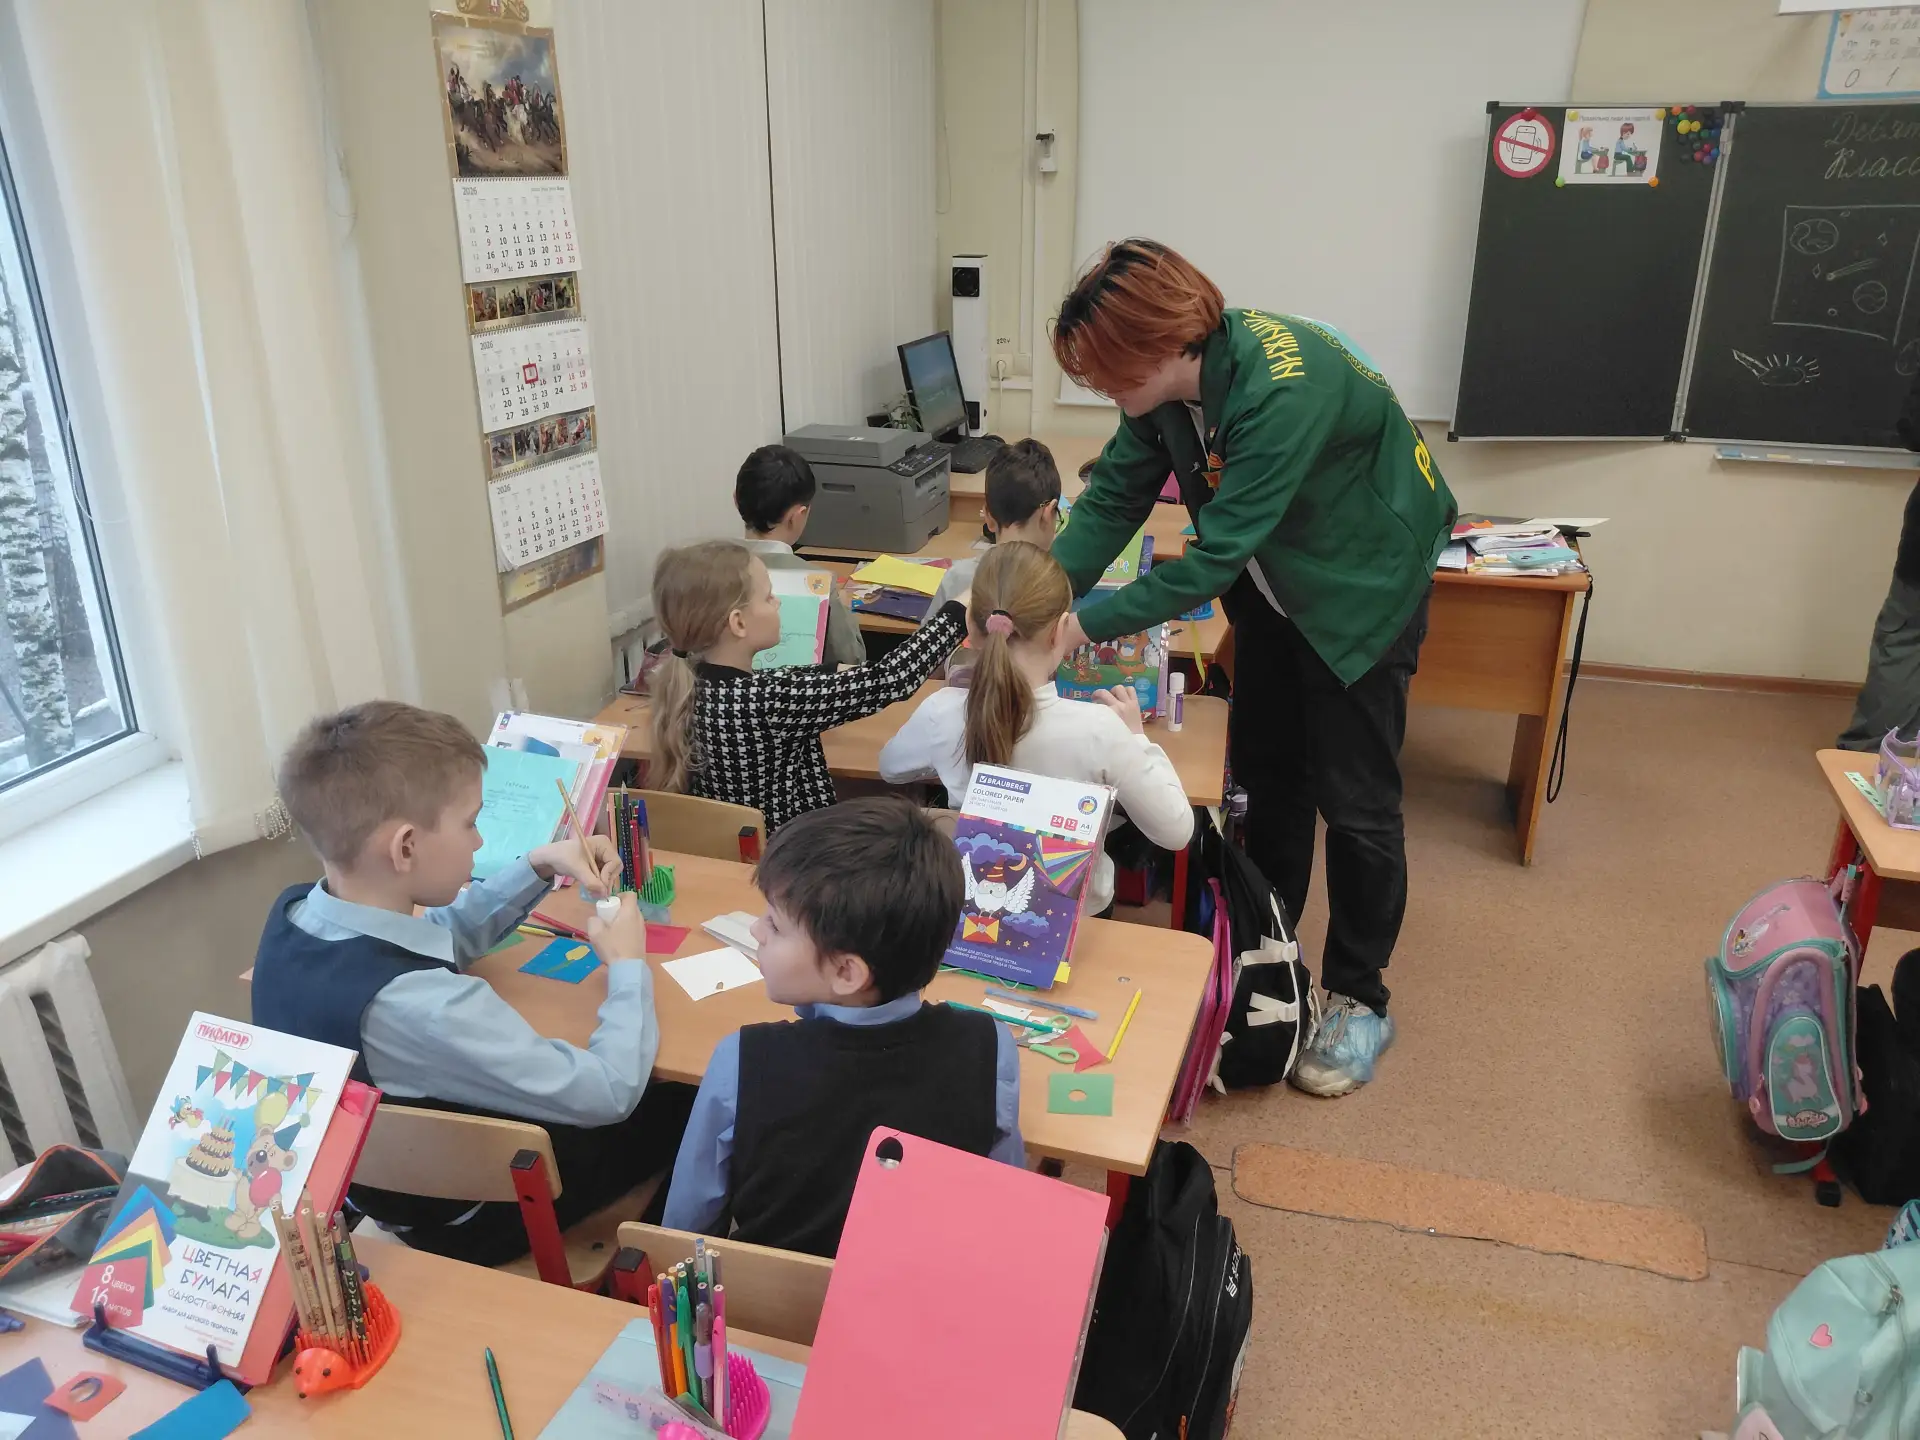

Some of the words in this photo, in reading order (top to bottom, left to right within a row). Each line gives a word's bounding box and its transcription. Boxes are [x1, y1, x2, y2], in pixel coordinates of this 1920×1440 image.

[462, 187, 477, 195] 2026
[480, 341, 493, 350] 2026
[496, 484, 511, 494] 2026
[973, 787, 1002, 799] COLORED
[1003, 794, 1025, 804] PAPER
[987, 777, 1024, 790] BRAUBERG
[198, 1024, 249, 1046] ПИФАГОР
[182, 1244, 263, 1284] ЦВЕТНАЯ
[102, 1265, 114, 1284] 8
[111, 1279, 135, 1293] ЦВЕТОВ
[180, 1269, 250, 1306] БУМАГА
[90, 1286, 108, 1306] 16
[108, 1304, 132, 1316] ЛИСТОВ
[168, 1288, 246, 1322] ОДНОСТОРОННЯЯ
[162, 1305, 177, 1314] НАБОР
[186, 1314, 210, 1325] ДЕТСКОГО
[210, 1322, 238, 1336] ТВОРЧЕСТВА
